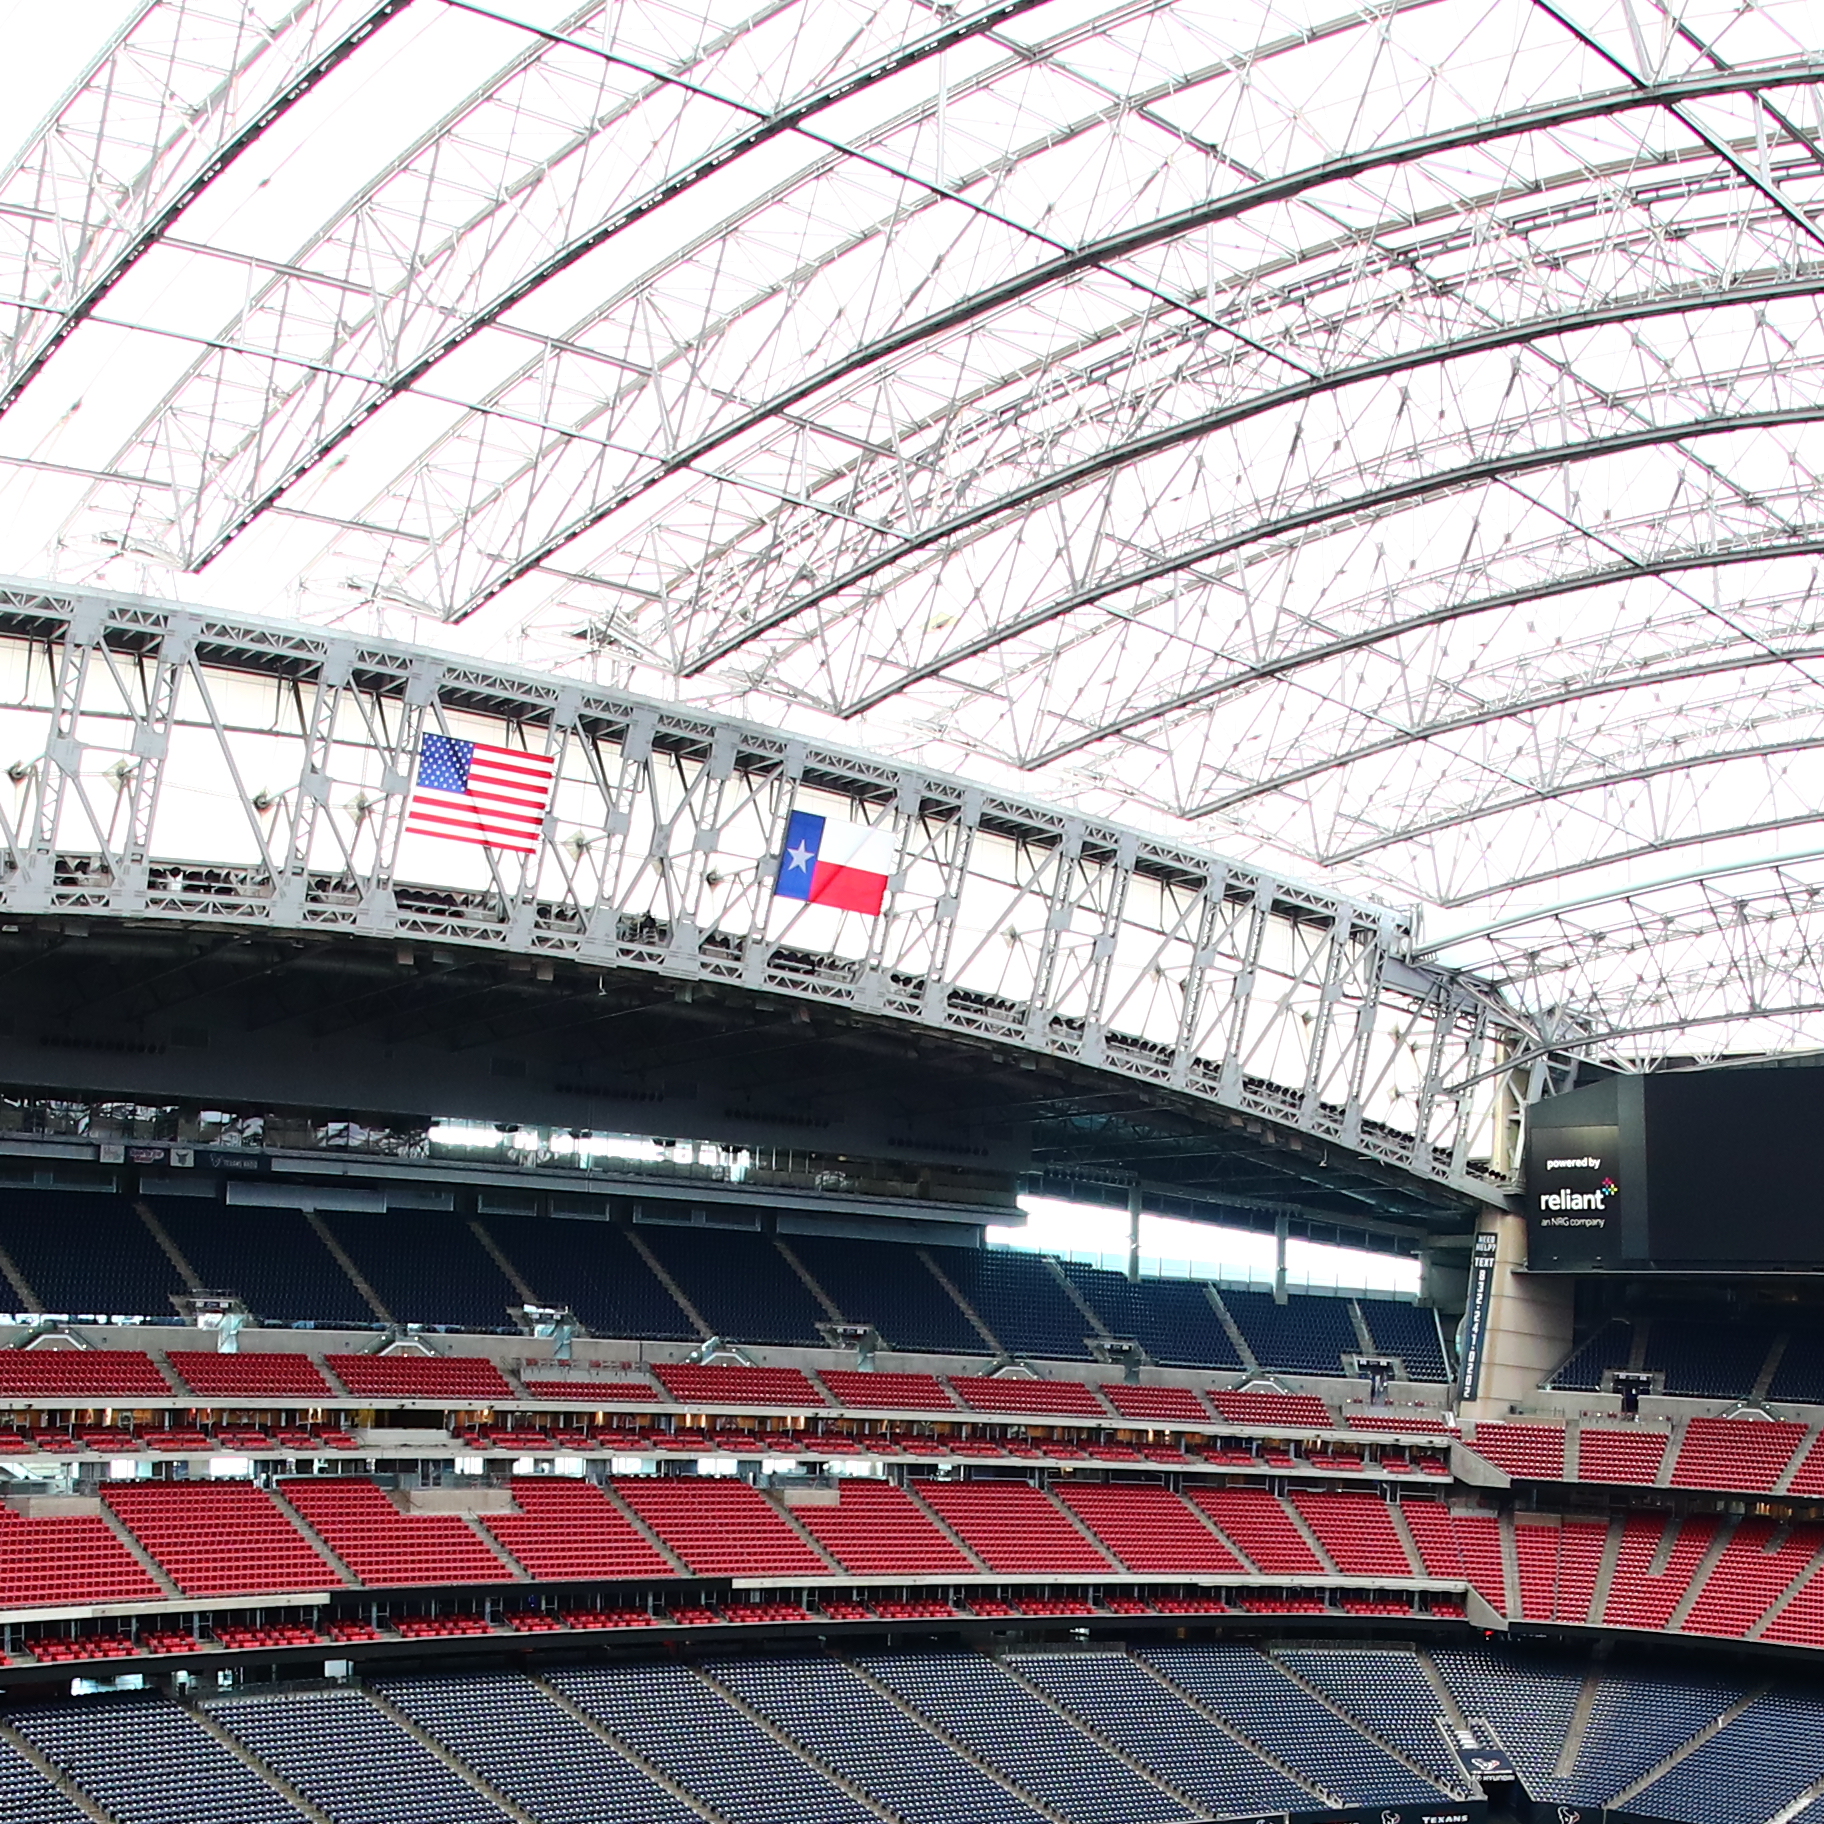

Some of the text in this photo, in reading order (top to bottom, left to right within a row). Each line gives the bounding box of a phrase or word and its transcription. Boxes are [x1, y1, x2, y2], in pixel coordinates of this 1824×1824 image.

[1547, 1157, 1601, 1170] powered by
[1540, 1188, 1605, 1210] reliant
[1541, 1217, 1605, 1228] an NRG company
[1474, 1257, 1495, 1267] TEXT
[1421, 1814, 1468, 1824] TEXANS
